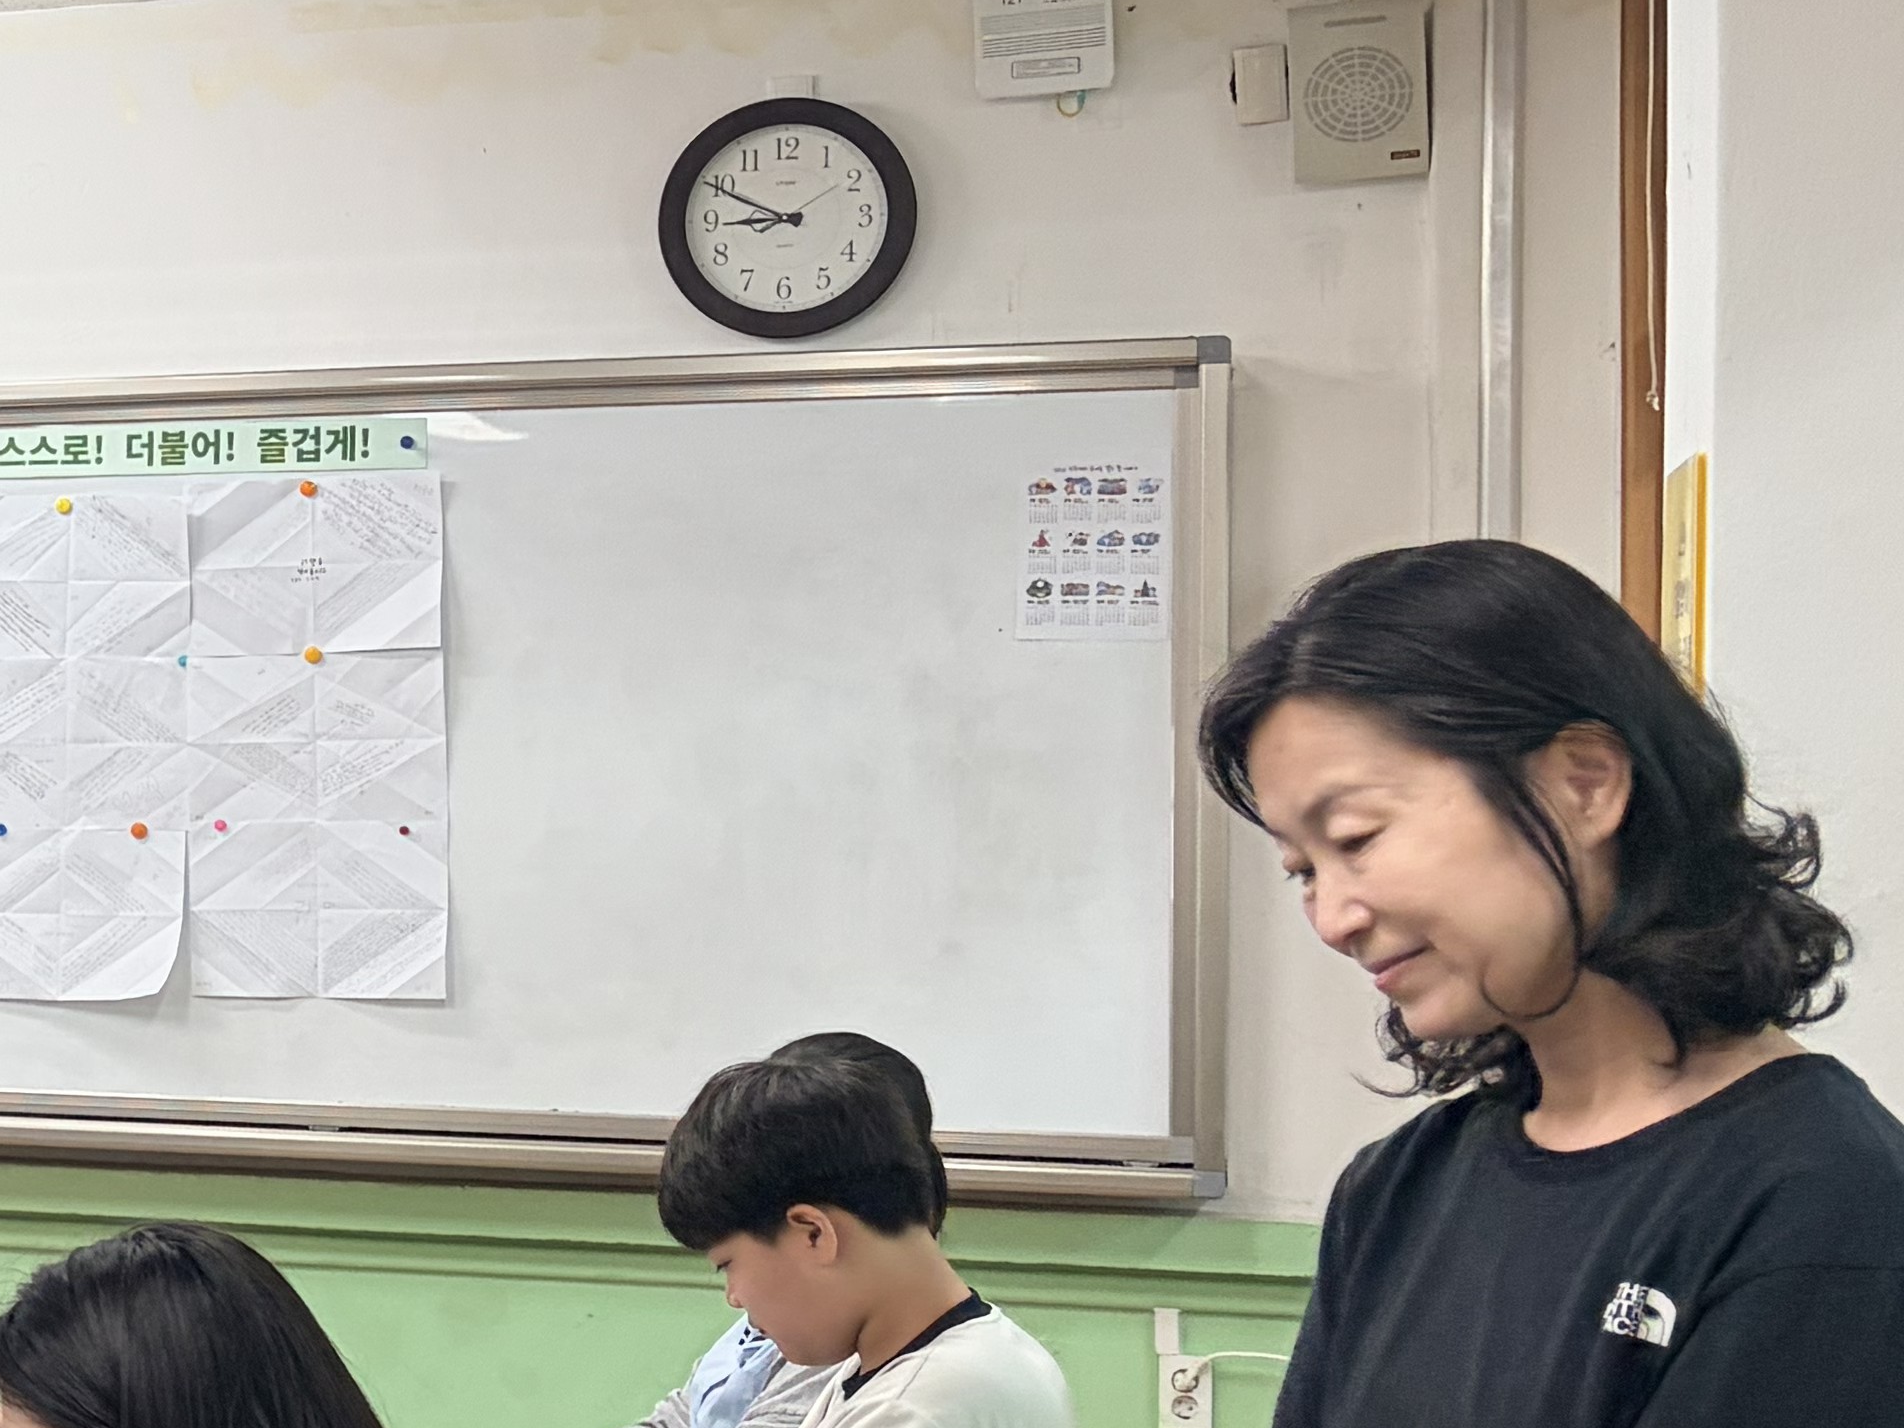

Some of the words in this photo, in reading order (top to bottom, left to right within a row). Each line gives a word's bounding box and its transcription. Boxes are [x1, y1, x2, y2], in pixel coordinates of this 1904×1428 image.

[776, 137, 799, 160] 12
[823, 146, 831, 168] 1
[740, 149, 759, 172] 11
[847, 169, 862, 192] 2
[704, 209, 719, 232] 9
[858, 204, 872, 227] 3
[713, 243, 728, 266] 8
[840, 239, 857, 262] 4
[740, 269, 754, 292] 7
[776, 277, 792, 300] 6
[816, 267, 831, 290] 5
[126, 430, 235, 466] 더불어!
[257, 426, 370, 463] 즐겁게!
